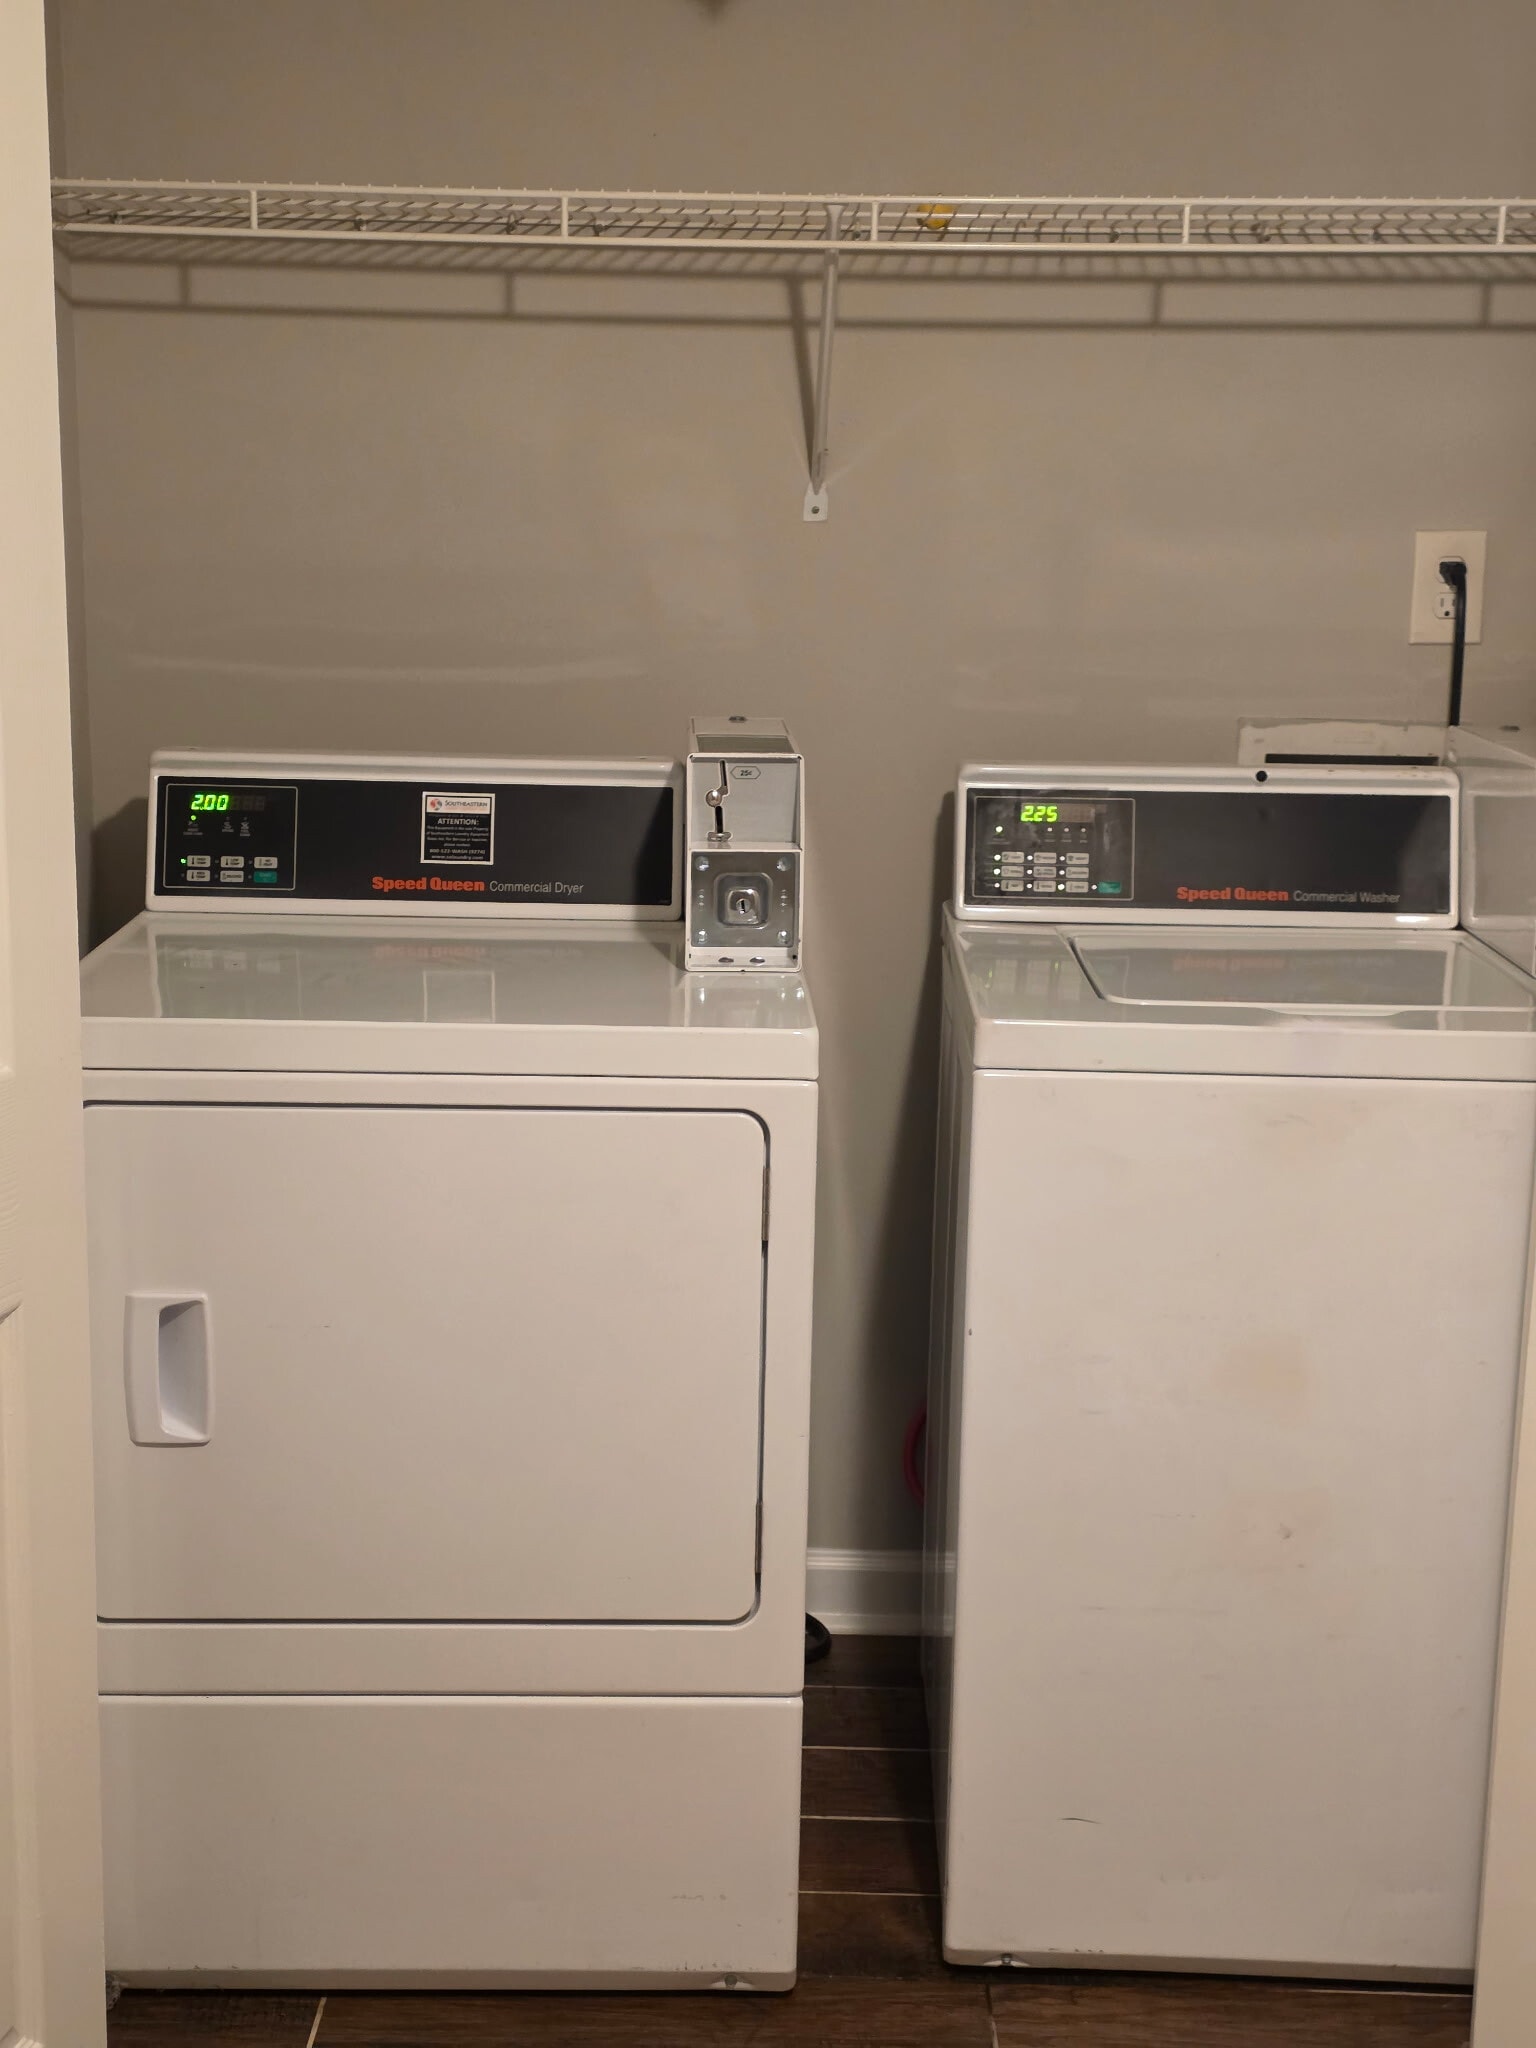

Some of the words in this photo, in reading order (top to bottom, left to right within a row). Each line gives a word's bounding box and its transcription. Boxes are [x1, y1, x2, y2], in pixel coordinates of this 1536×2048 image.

[437, 818, 480, 826] ATTENTION:
[371, 876, 427, 892] Speed
[429, 877, 485, 891] Queen
[489, 880, 552, 893] Commercial
[554, 881, 584, 896] Dryer
[1176, 886, 1231, 902] Speed
[1233, 887, 1289, 901] Queen
[1292, 890, 1357, 902] Commercial
[1359, 891, 1400, 903] Washer
